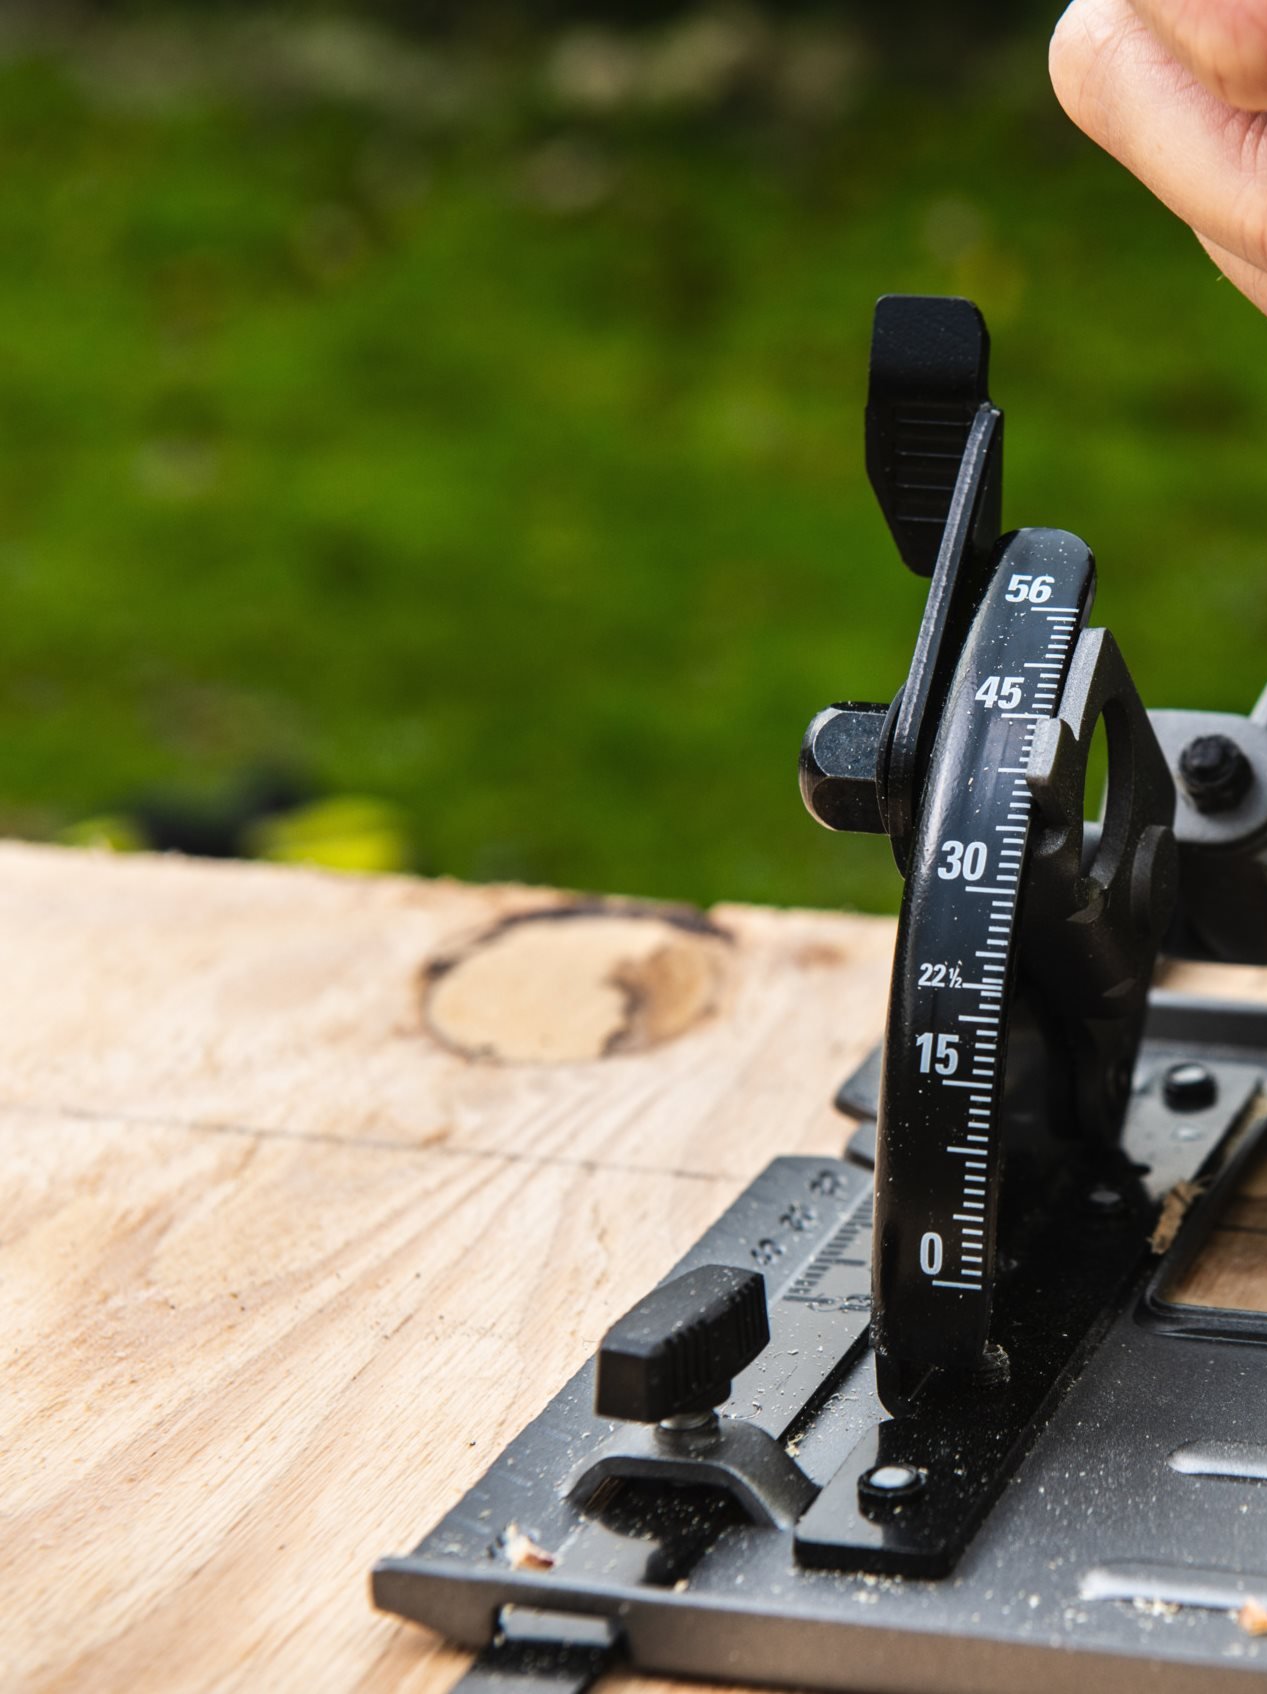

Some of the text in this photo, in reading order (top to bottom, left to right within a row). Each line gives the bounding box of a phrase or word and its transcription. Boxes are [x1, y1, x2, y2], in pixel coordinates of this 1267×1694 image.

[1004, 574, 1055, 604] 56
[974, 676, 1025, 710] 45
[937, 840, 988, 881] 30
[915, 1032, 960, 1075] 15
[920, 1231, 943, 1275] 0
